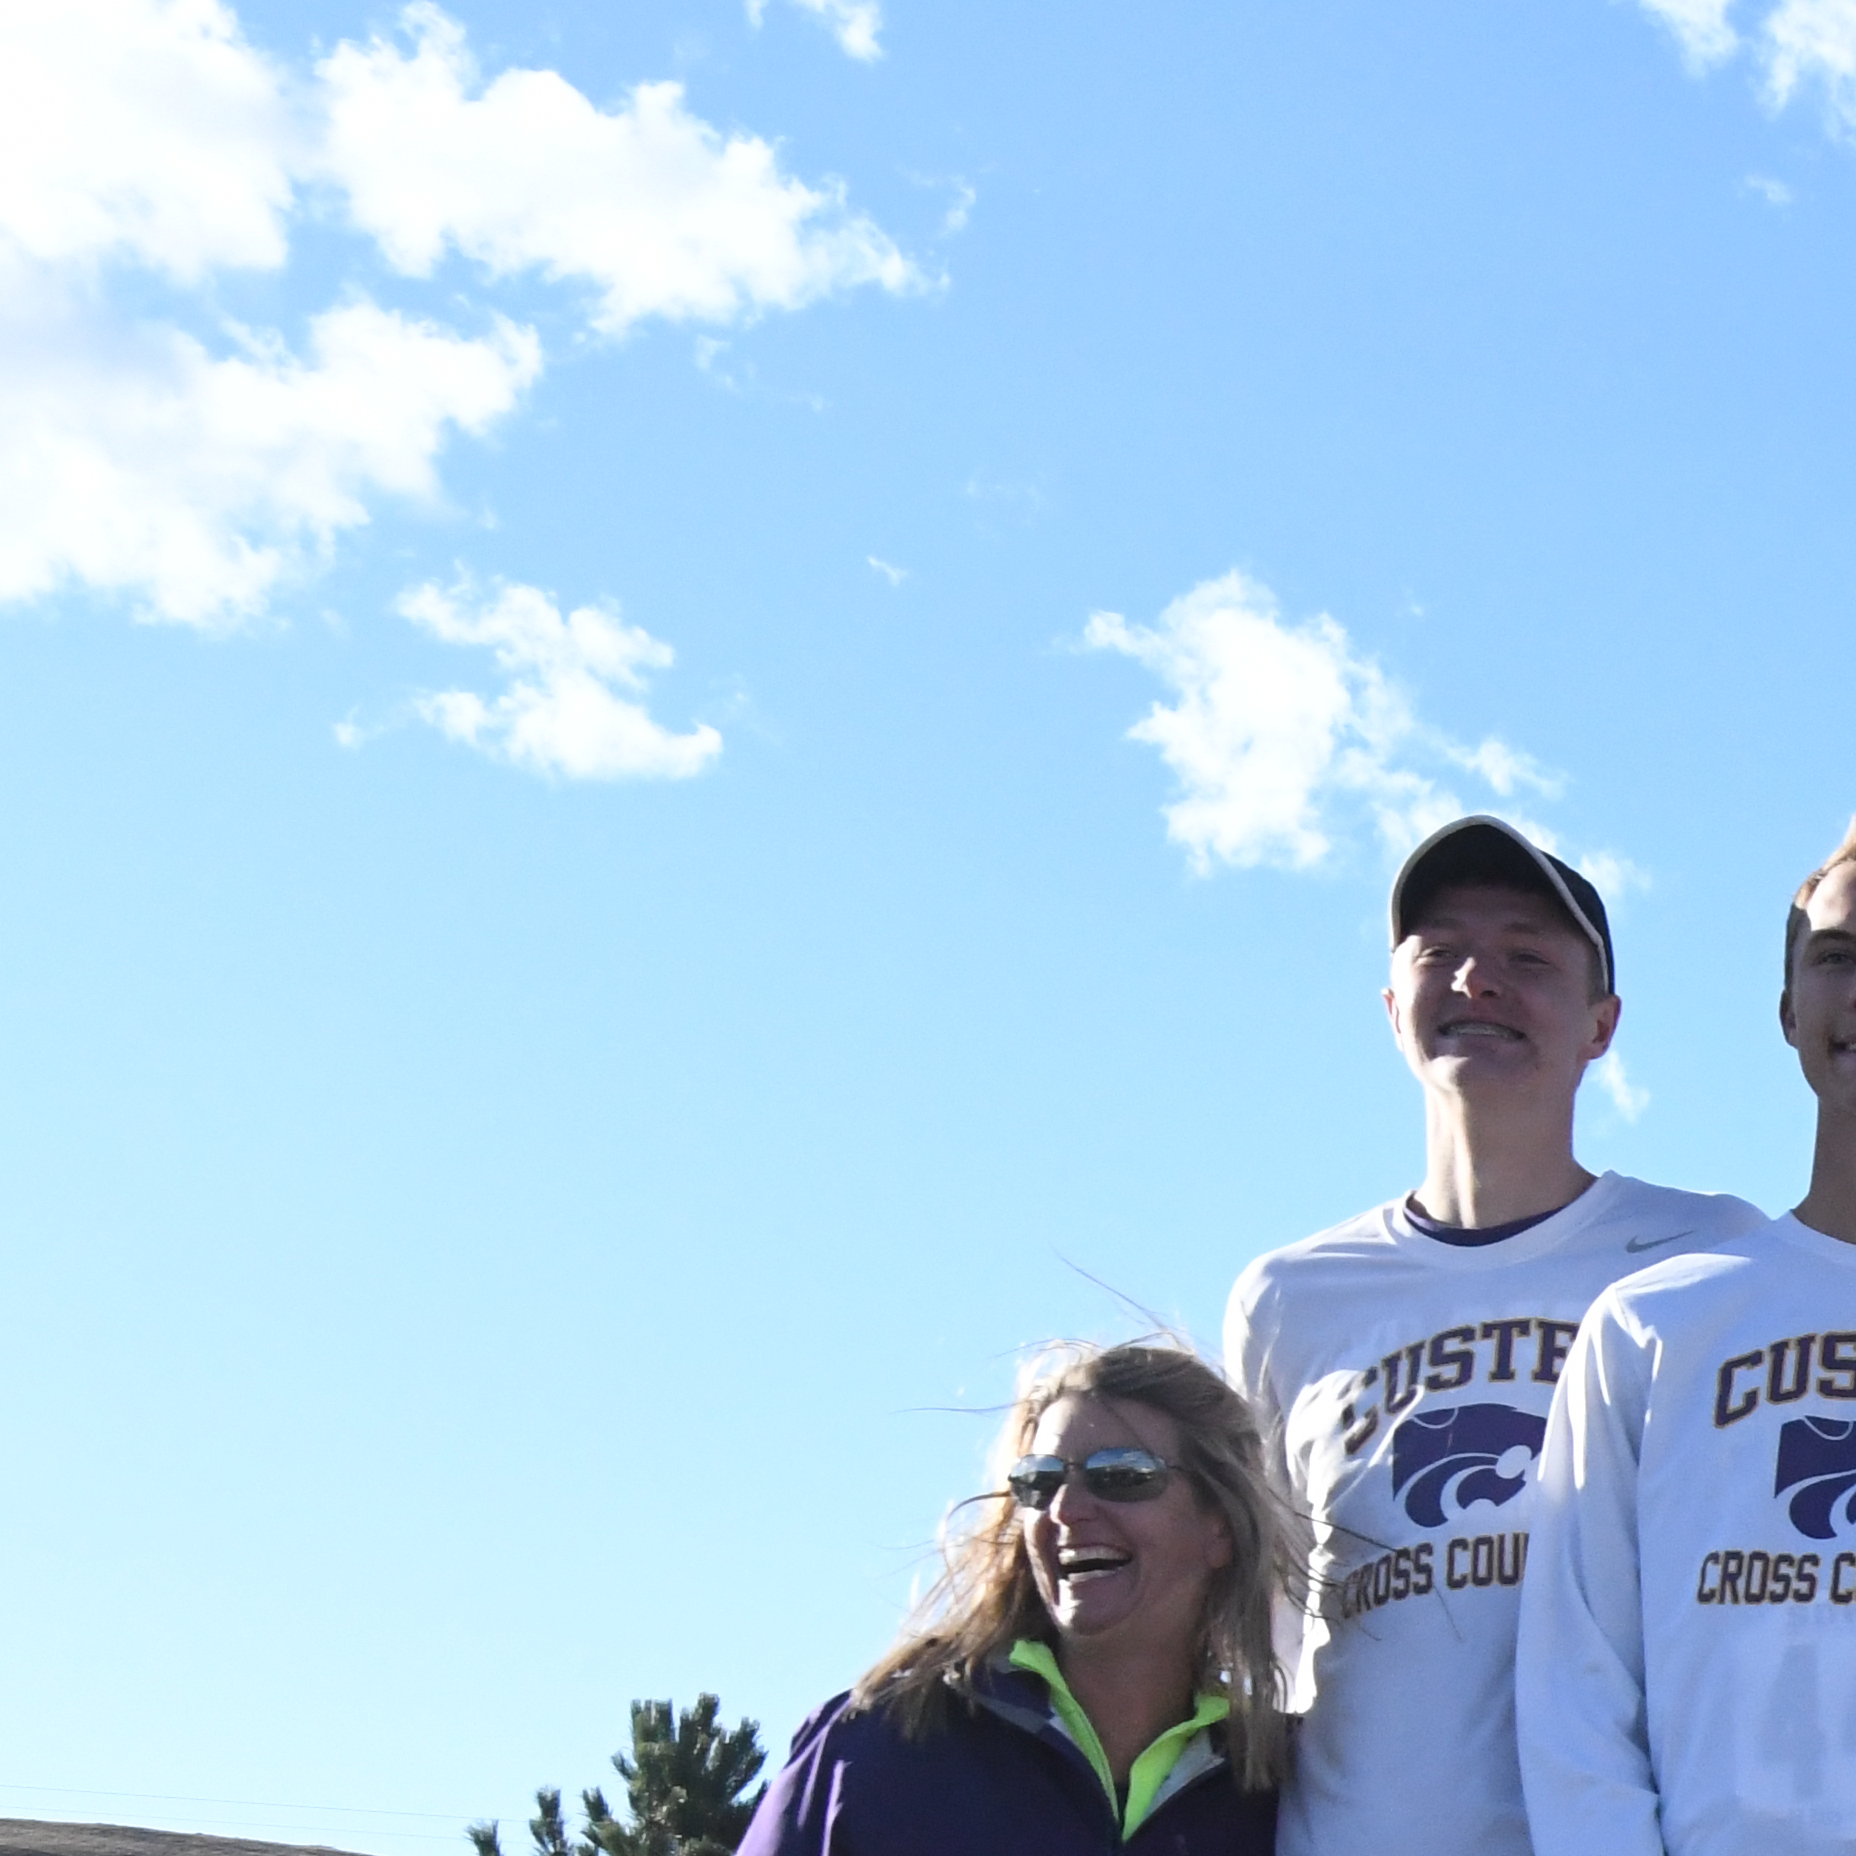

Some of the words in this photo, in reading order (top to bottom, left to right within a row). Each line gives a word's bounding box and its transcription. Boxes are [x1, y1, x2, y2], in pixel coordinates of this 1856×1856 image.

[1340, 1317, 1579, 1455] CUSTE
[1341, 1542, 1434, 1619] CROSS
[1696, 1550, 1821, 1606] CROSS
